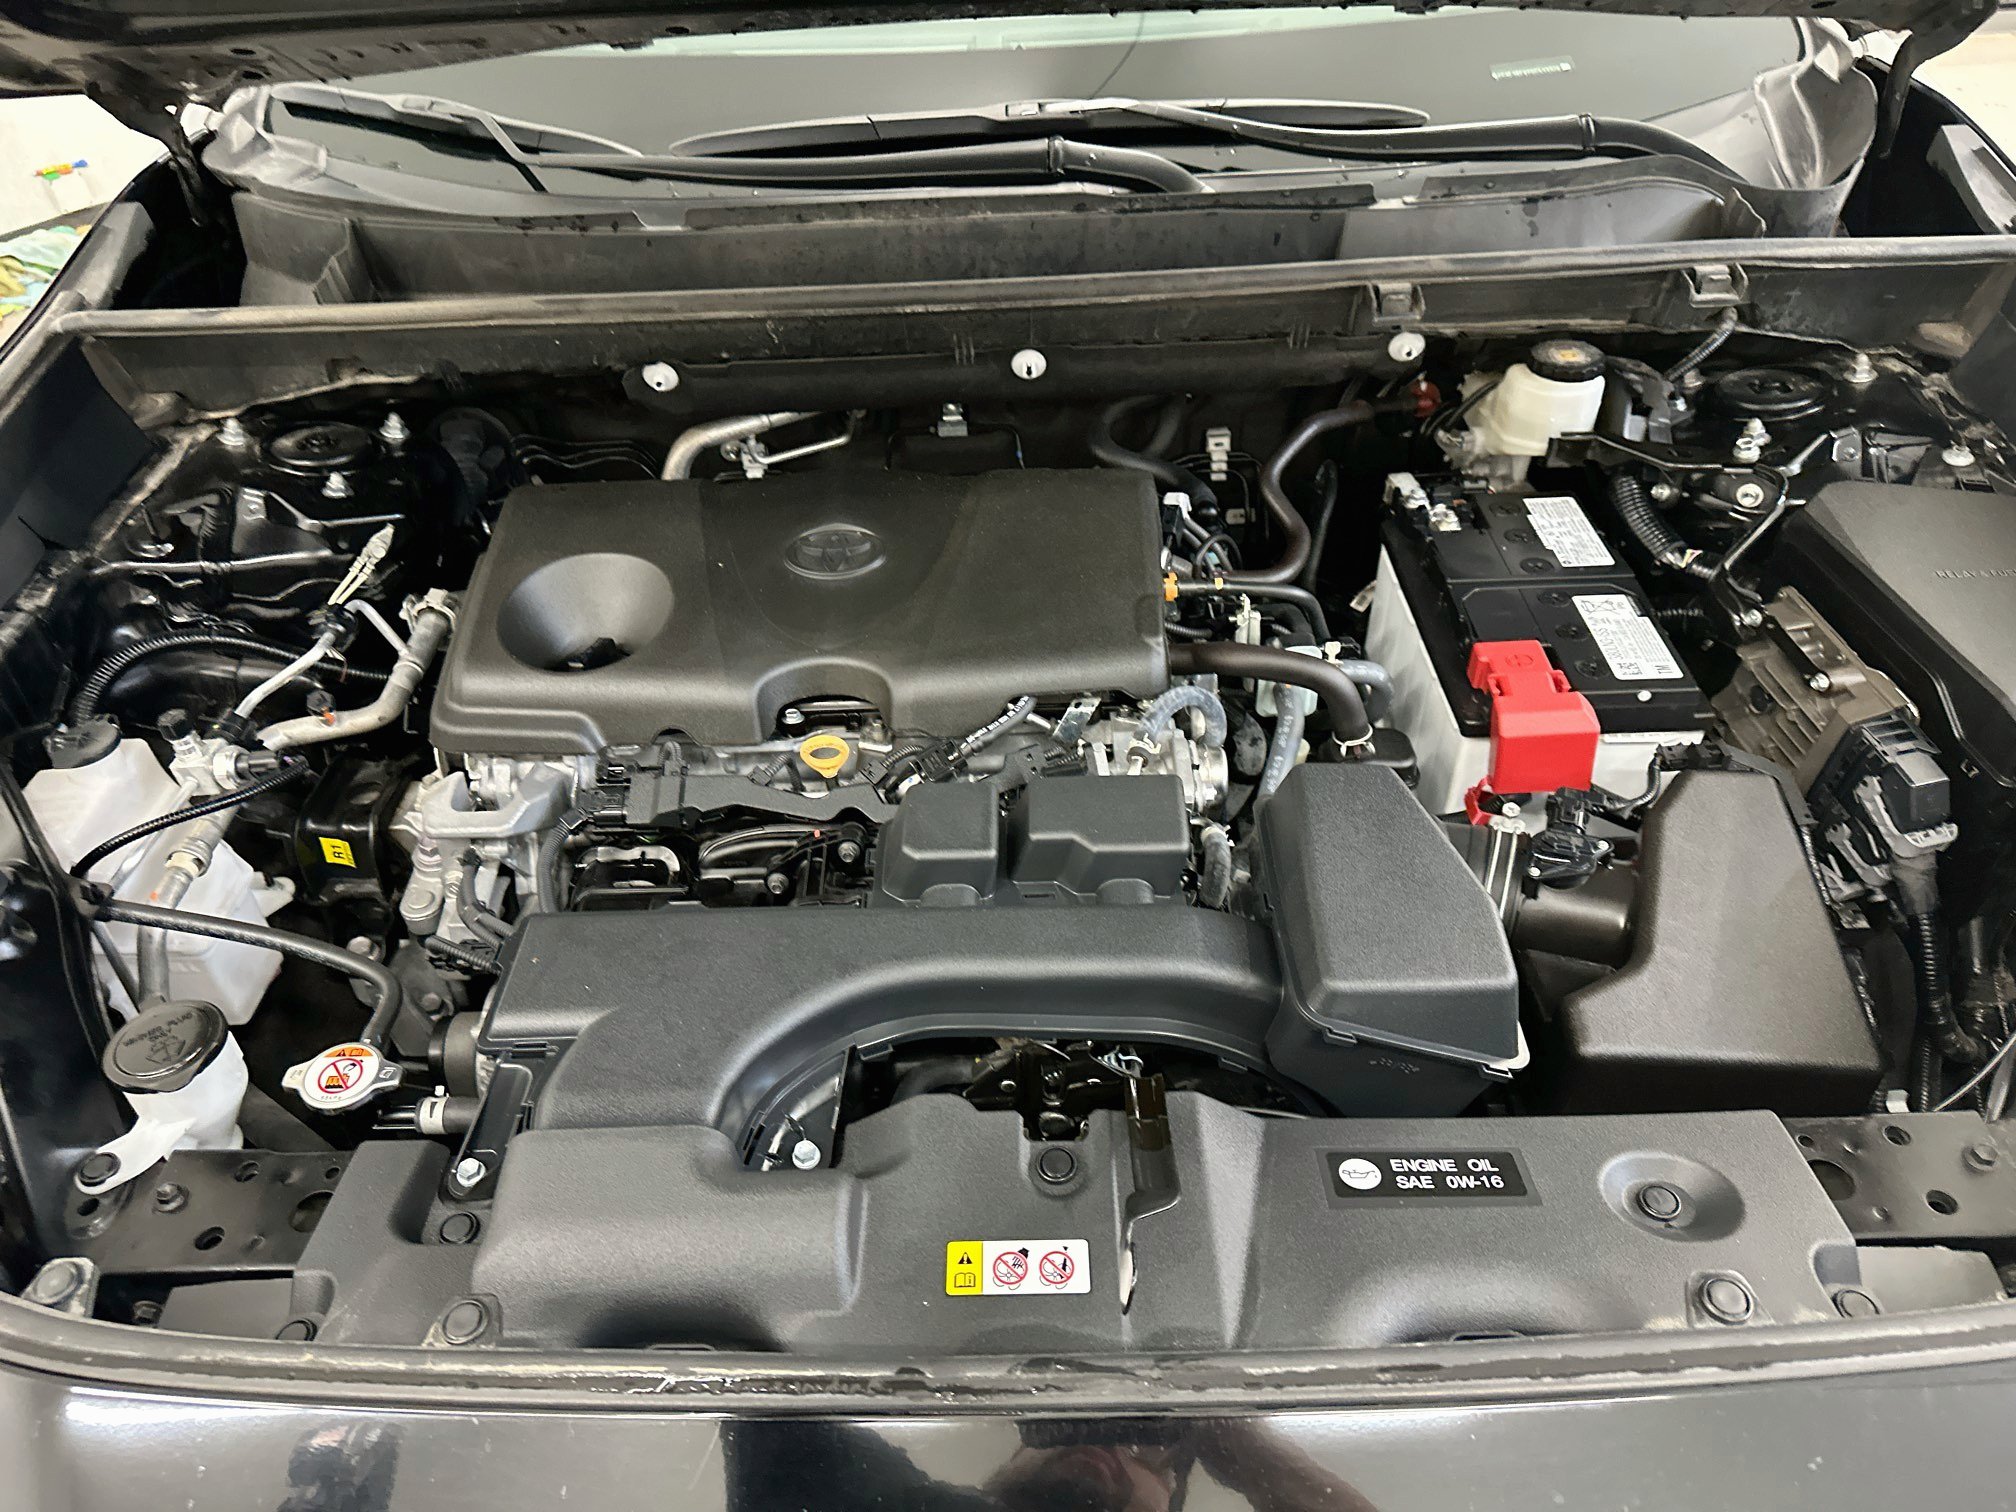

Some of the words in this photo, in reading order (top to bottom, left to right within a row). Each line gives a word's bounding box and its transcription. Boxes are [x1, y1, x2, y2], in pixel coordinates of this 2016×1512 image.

[332, 845, 345, 859] R1
[1389, 1158, 1458, 1172] ENGINE
[1466, 1158, 1500, 1172] OIL
[1395, 1175, 1435, 1189] SAE
[1445, 1175, 1505, 1189] 0W-16
